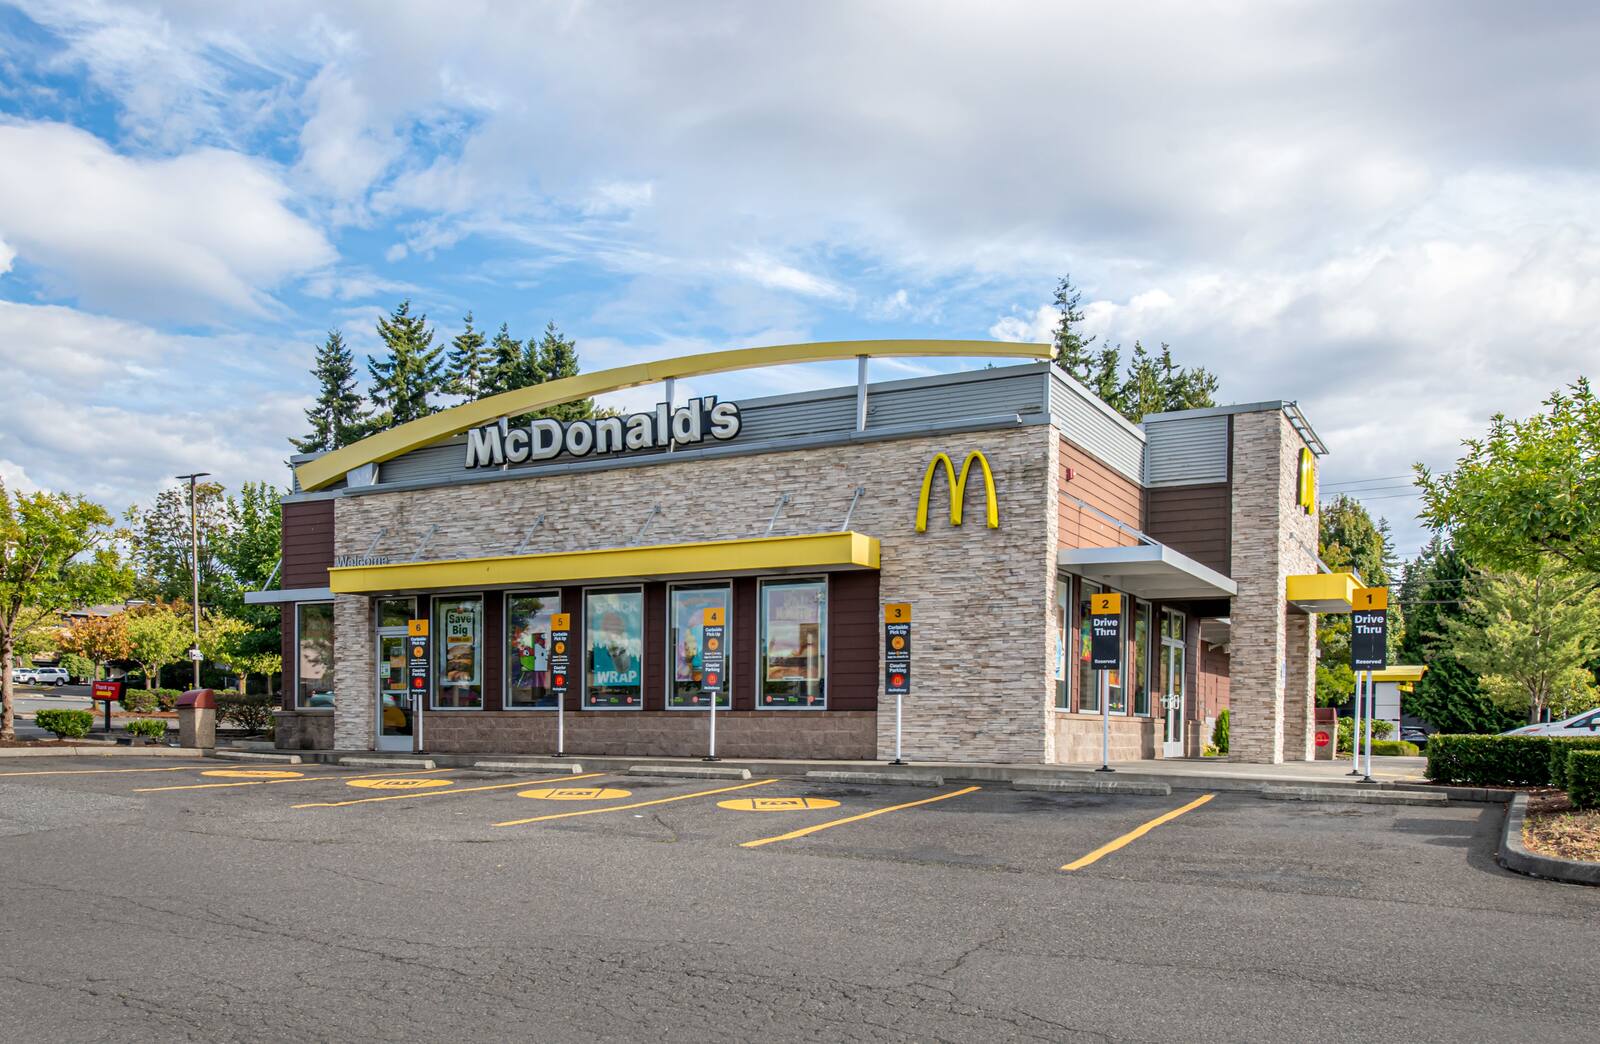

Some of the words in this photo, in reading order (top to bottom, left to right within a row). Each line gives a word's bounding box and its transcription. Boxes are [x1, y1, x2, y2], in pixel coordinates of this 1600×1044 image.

[464, 395, 742, 468] McDonald's
[1366, 594, 1372, 604] 1
[1102, 600, 1109, 608] 2
[711, 612, 717, 621] 4
[895, 608, 902, 618] 3
[449, 615, 472, 623] Save
[1093, 618, 1118, 626] Drive
[1354, 614, 1384, 624] Drive
[453, 624, 468, 637] Big
[1094, 628, 1116, 636] Thru
[1356, 625, 1382, 634] Thru
[597, 670, 638, 682] WRAP
